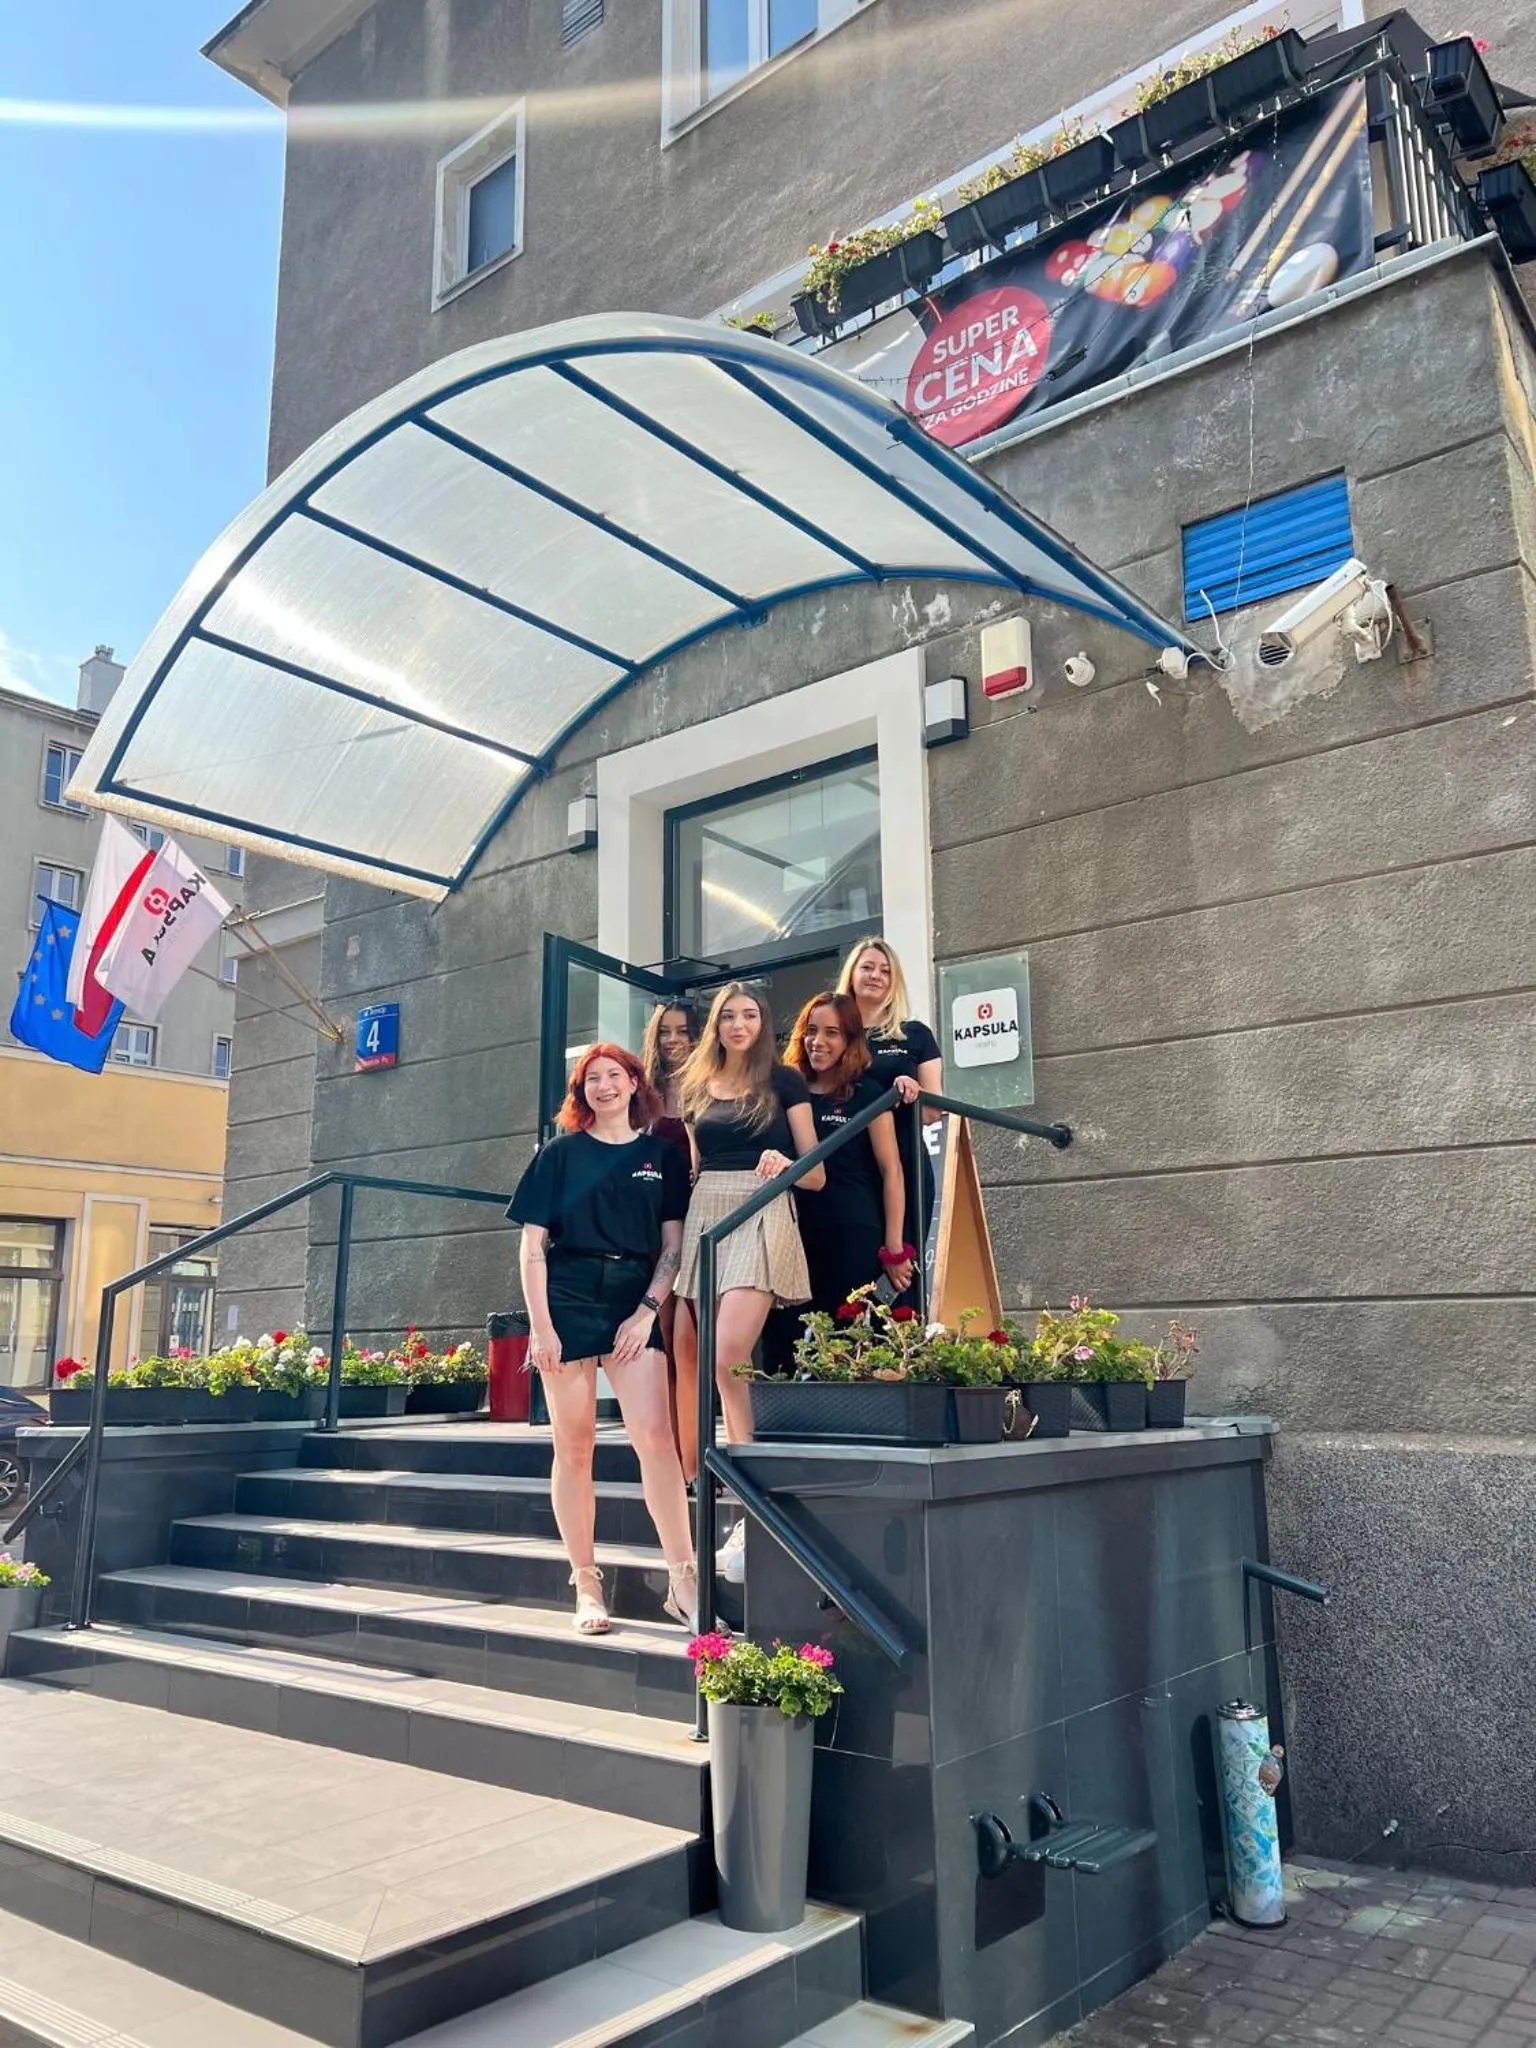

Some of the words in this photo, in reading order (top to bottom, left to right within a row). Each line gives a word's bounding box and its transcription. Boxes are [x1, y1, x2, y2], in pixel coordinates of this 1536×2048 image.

[932, 305, 1019, 364] SUPER
[914, 328, 1038, 411] CENA
[923, 413, 947, 430] ZA
[366, 1020, 380, 1053] 4
[954, 1020, 1018, 1041] KAPSUŁA
